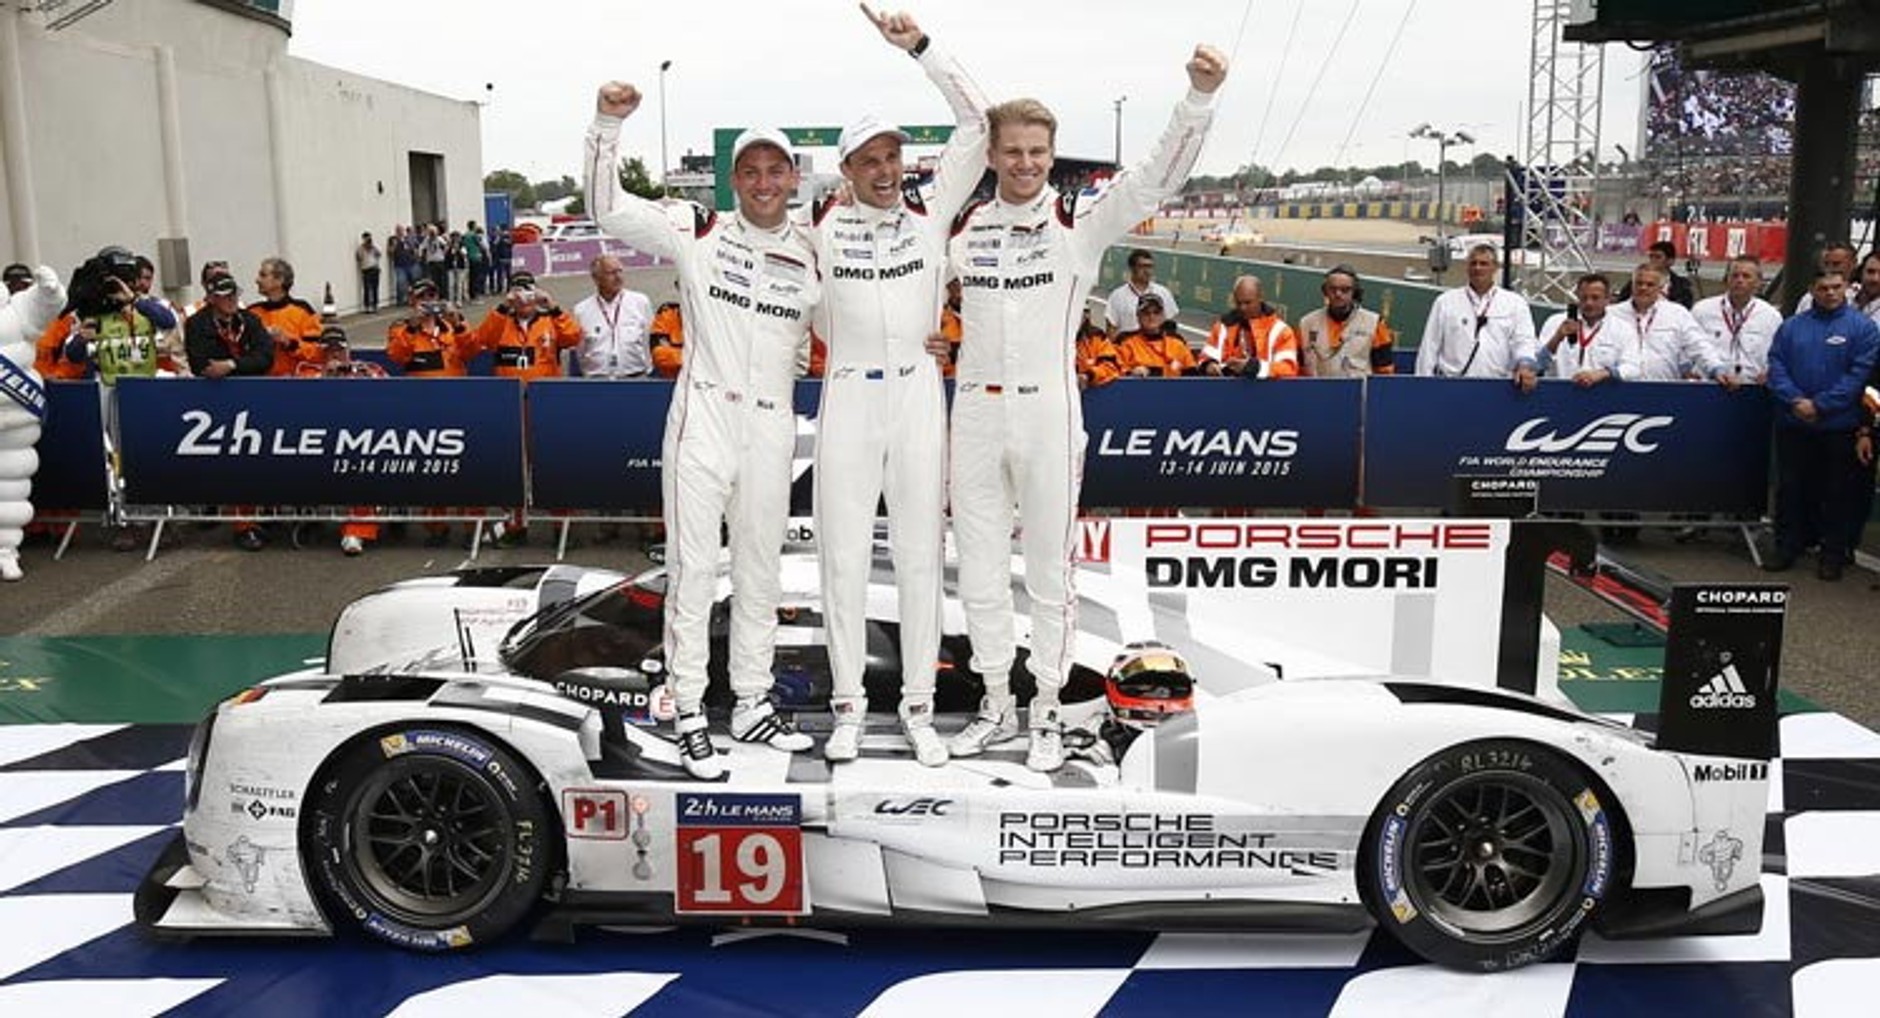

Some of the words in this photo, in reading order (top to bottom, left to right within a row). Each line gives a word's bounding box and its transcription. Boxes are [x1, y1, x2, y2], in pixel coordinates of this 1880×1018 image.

[833, 266, 875, 280] DMG
[879, 258, 924, 280] MORI
[963, 276, 999, 289] DMG
[1004, 272, 1054, 289] MORI
[709, 285, 751, 309] DMG
[756, 302, 801, 320] MORI
[176, 410, 263, 455] 24h
[272, 429, 327, 455] LE
[335, 429, 465, 455] MANS
[1098, 429, 1157, 456] LE
[1163, 429, 1299, 456] MANS
[1505, 413, 1674, 453] WEC
[333, 459, 375, 474] 13-14
[381, 459, 416, 474] JUIN
[422, 459, 461, 474] 2015
[1160, 461, 1203, 475] 13-14
[1209, 461, 1247, 475] JUIN
[1251, 461, 1292, 475] 2015
[1459, 457, 1480, 466] FIA
[1483, 457, 1528, 467] WORLD
[1529, 458, 1609, 468] ENDURANCE
[1509, 469, 1605, 478] CHAMPIONSHIP
[1471, 481, 1536, 490] CHOPARD
[1146, 524, 1490, 548] PORSCHE
[1146, 557, 1277, 588] DMG
[1289, 557, 1438, 588] MORI
[1697, 590, 1786, 603] CHOPARD
[556, 681, 649, 706] CHOPARD
[1690, 692, 1756, 709] adidas
[416, 734, 485, 762] MICHELIN
[1694, 764, 1747, 781] Mobil
[573, 798, 616, 831] P1
[721, 804, 742, 816] LE
[744, 804, 794, 816] MANS
[874, 798, 954, 816] WEC
[1000, 813, 1215, 831] PORSCHE
[1000, 832, 1276, 849] INTELLIGENT
[1000, 850, 1338, 871] PERFORMANCE
[1384, 819, 1399, 891] MICHELIN
[1591, 824, 1609, 892] MICHELIN
[692, 832, 786, 904] 19
